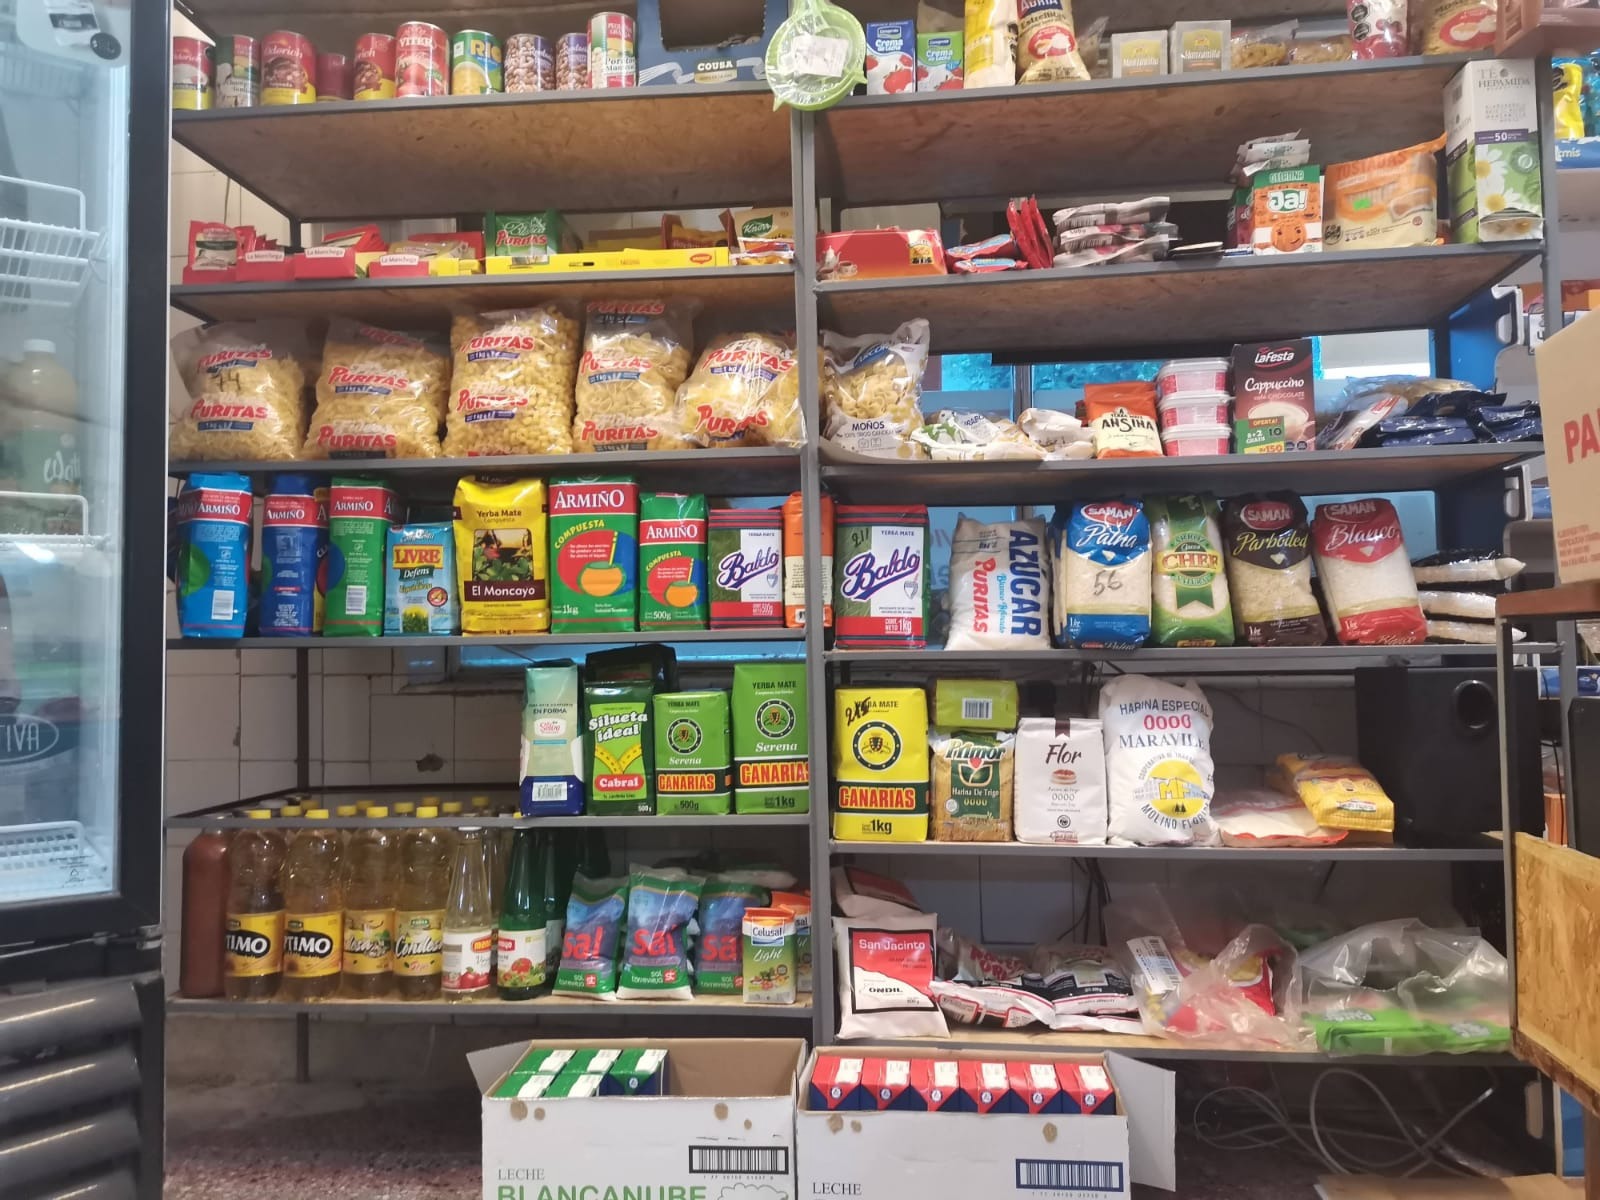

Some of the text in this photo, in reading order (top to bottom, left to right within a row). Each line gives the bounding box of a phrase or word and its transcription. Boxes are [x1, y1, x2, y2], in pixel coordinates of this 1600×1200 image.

[875, 39, 903, 48] Crema
[1494, 132, 1508, 142] 50
[1255, 351, 1295, 364] LaFesta
[328, 366, 409, 389] PURITAS
[1244, 377, 1305, 395] Cappuccino
[191, 399, 269, 419] PURITAS
[852, 420, 885, 431] MOÑOS
[1102, 418, 1153, 433] ANSINA
[318, 425, 397, 449] PURITAS
[335, 499, 374, 512] ARMIÑO
[554, 489, 625, 510] ARMIÑO
[1331, 500, 1376, 515] SAMAN
[198, 502, 241, 516] ARMIÑO
[266, 507, 305, 520] ARMIÑO
[476, 509, 522, 518] Yerba Mate
[1088, 505, 1133, 519] SAMAN
[1248, 507, 1291, 522] SAMAN
[554, 519, 605, 549] COMPUESTA
[646, 524, 698, 540] ARMIÑO
[1076, 523, 1137, 548] Patna
[1326, 524, 1398, 550] Blanco
[1233, 529, 1309, 555] Parboiled
[394, 548, 441, 564] LIVRE
[646, 550, 682, 572] COMPUESTA
[403, 567, 430, 579] Defens
[719, 546, 779, 590] Baldo
[843, 546, 920, 600] Baldo
[1008, 529, 1042, 636] AZUCAR
[472, 585, 536, 598] El Moncayo
[973, 557, 996, 633] PURITAS
[752, 680, 797, 689] YERBA MATE
[879, 700, 899, 708] MATE
[1120, 699, 1209, 718] HARINA ESPECIAL
[588, 711, 648, 731] Silueta
[1143, 714, 1192, 731] 0000
[597, 724, 641, 743] ideal
[755, 742, 797, 753] Serena
[1045, 743, 1082, 765] Flor
[669, 757, 702, 765] Serena
[599, 776, 640, 788] Cabral
[658, 773, 716, 791] CANARIAS
[839, 786, 915, 809] CANARIAS
[952, 788, 972, 796] Harina
[1051, 793, 1075, 802] 0000
[1141, 803, 1177, 830] MOLINO
[871, 819, 892, 835] 1kg
[631, 923, 677, 956] sal
[753, 927, 782, 937] Celusal
[562, 925, 604, 960] sal
[702, 933, 737, 962] sa
[859, 938, 926, 951] San Jacinto
[753, 947, 783, 963] Light
[498, 1168, 545, 1181] LECHE
[812, 1181, 863, 1196] LECHE
